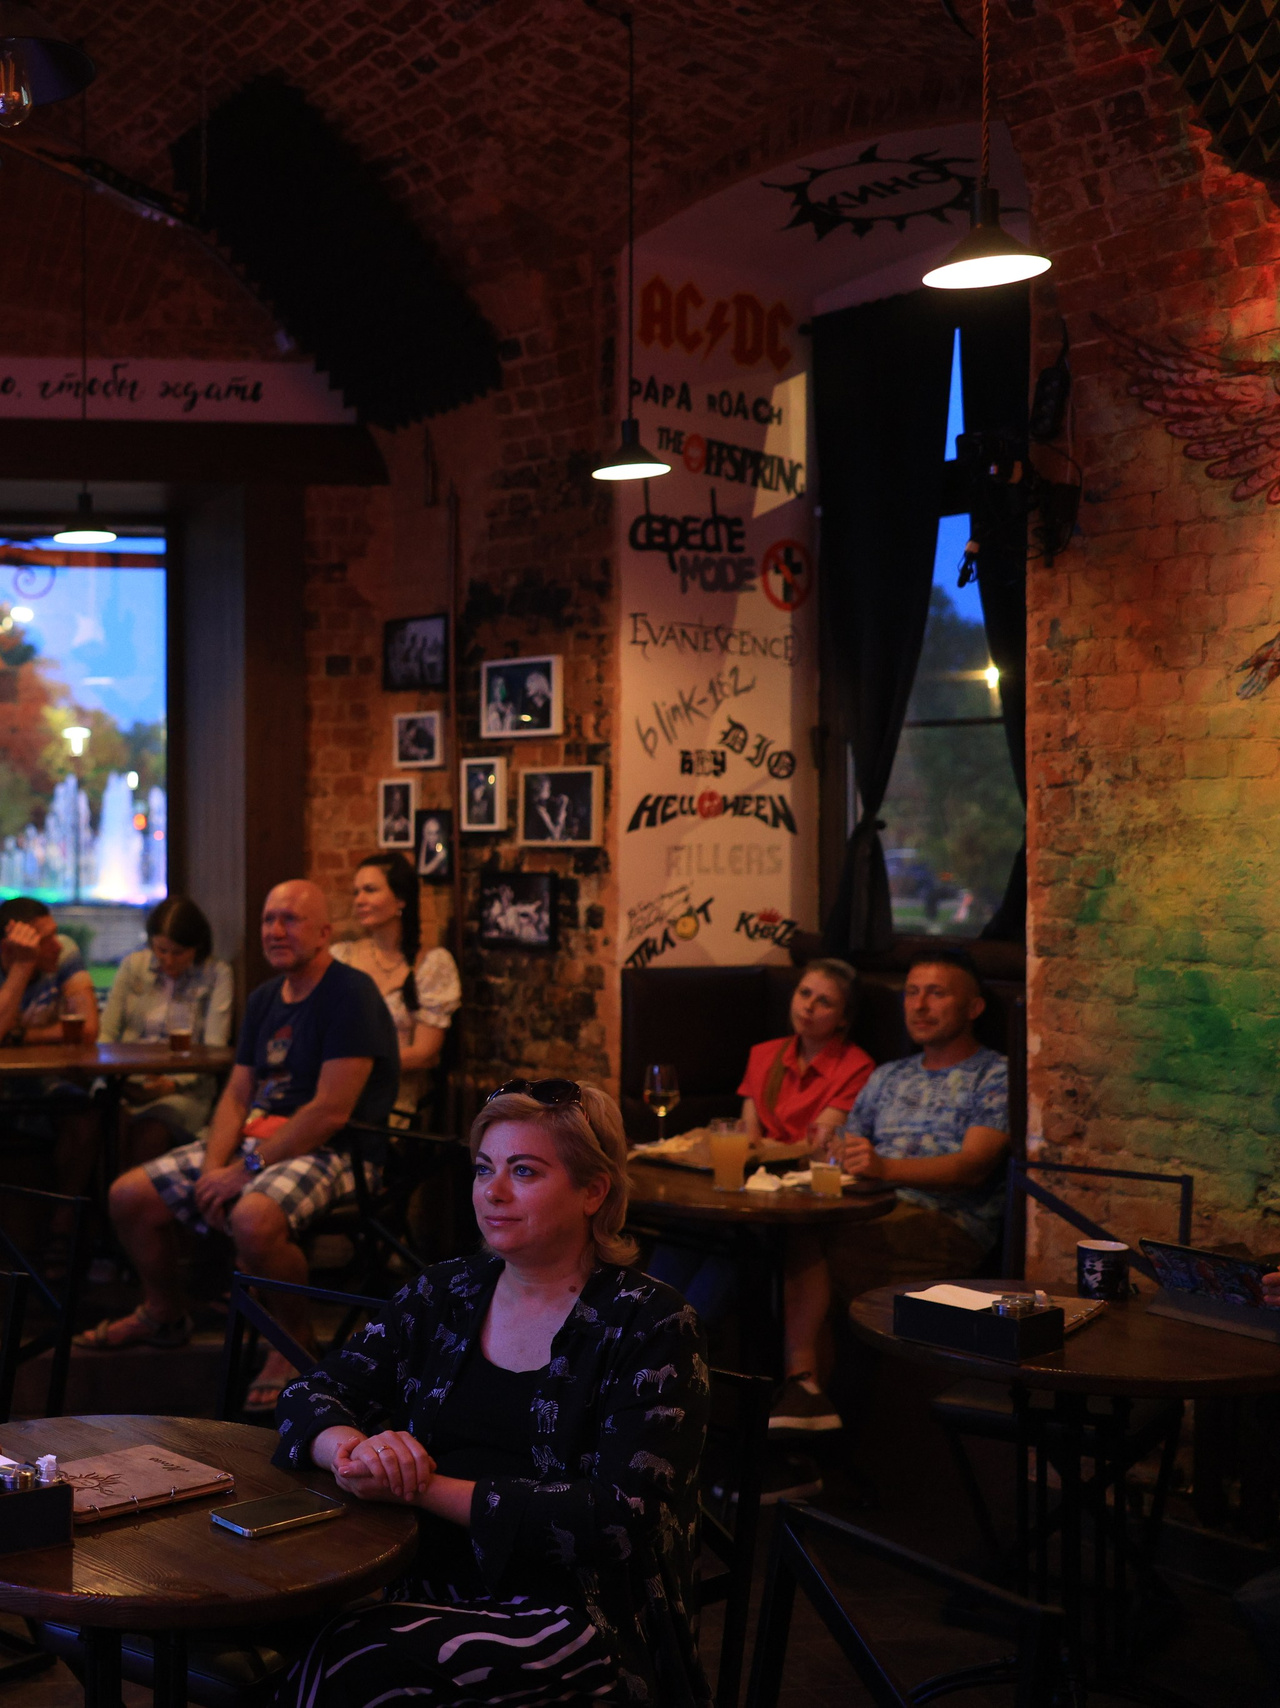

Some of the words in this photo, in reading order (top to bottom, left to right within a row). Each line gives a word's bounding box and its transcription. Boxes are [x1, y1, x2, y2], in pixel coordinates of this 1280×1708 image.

[158, 376, 263, 412] ждать
[629, 375, 693, 413] PAPA
[707, 389, 783, 426] ROACH
[657, 427, 685, 456] THE
[679, 555, 757, 594] MODE
[629, 612, 800, 667] EVANESCENCE
[626, 789, 798, 836] HELLOWEEN
